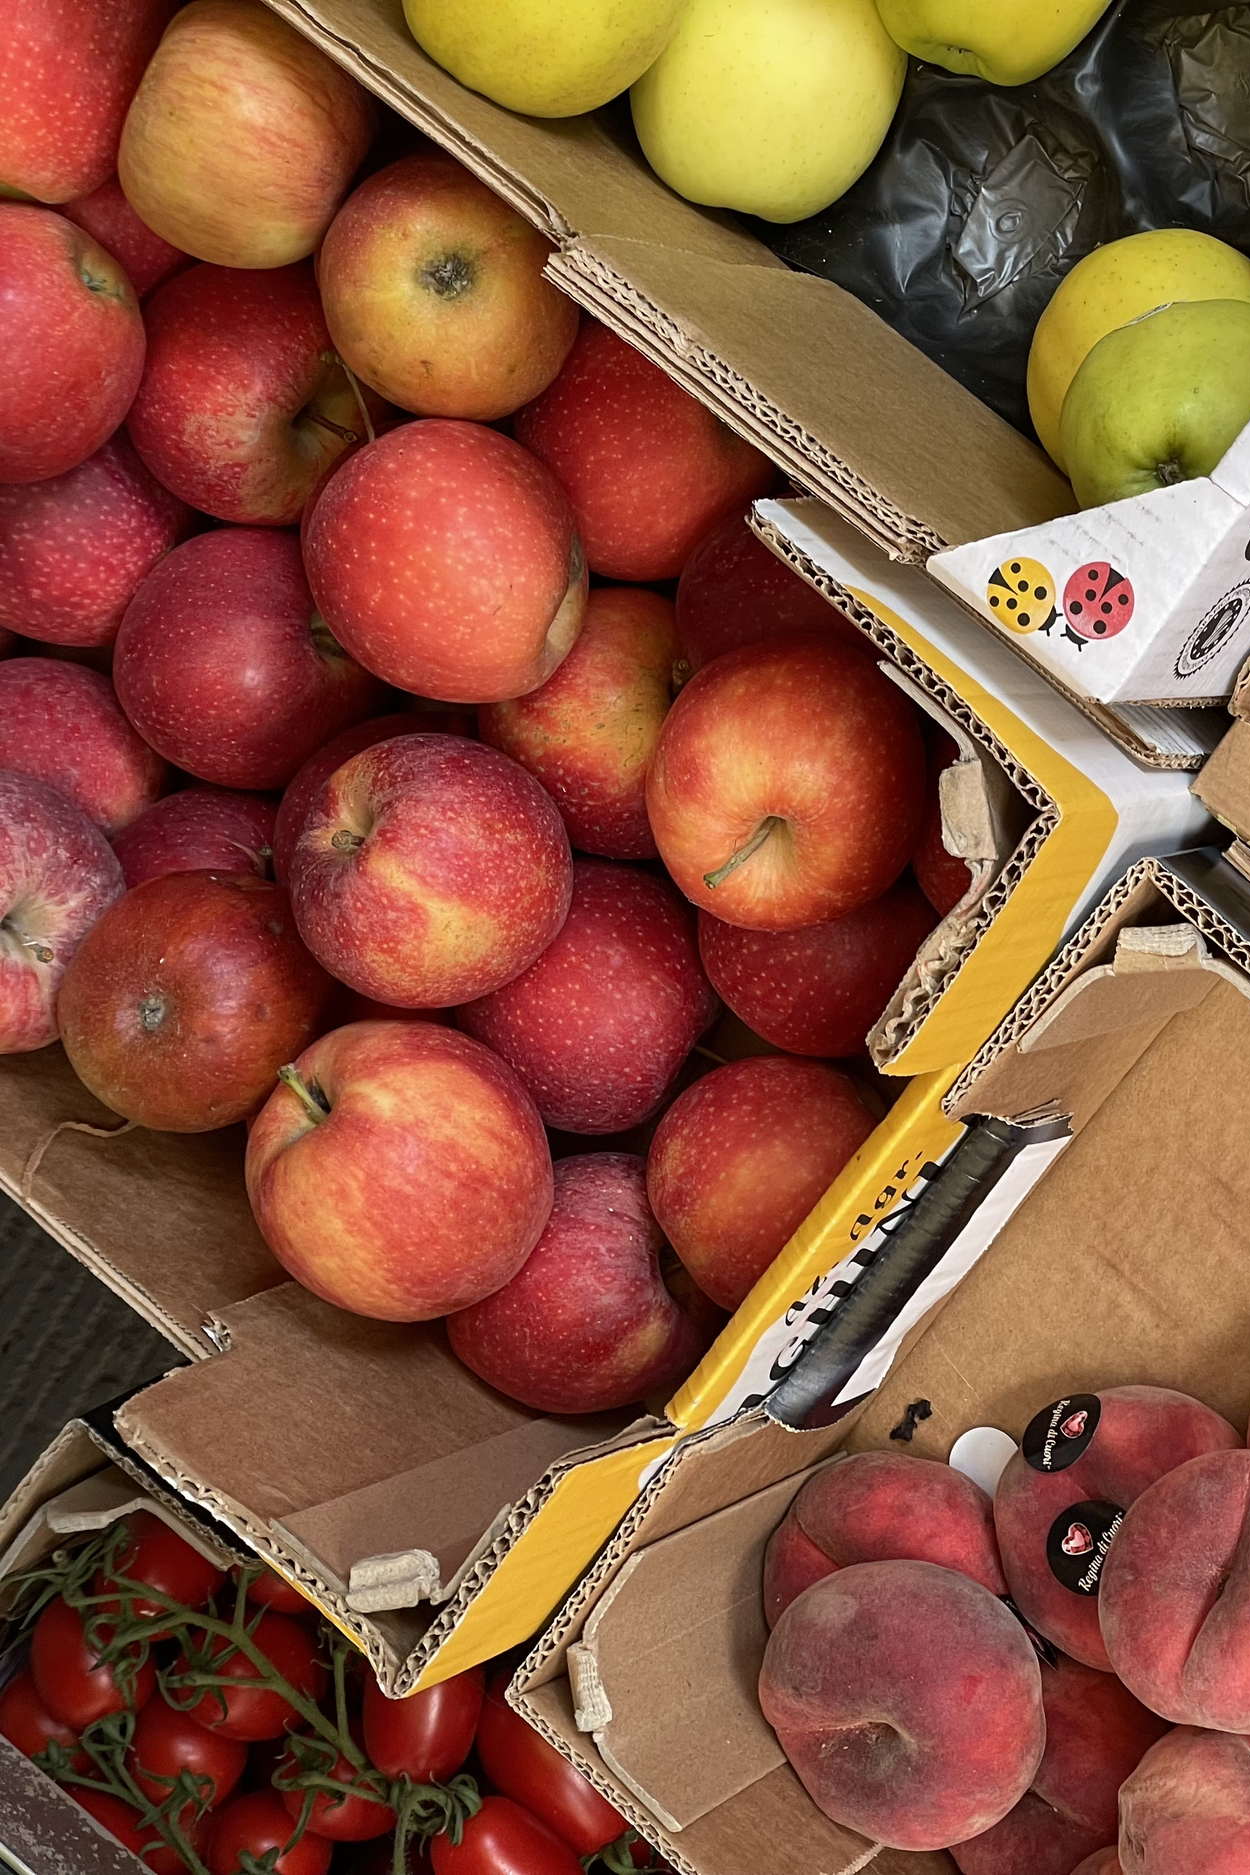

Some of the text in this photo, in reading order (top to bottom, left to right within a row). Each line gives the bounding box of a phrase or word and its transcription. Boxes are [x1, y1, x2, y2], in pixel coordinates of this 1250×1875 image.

[850, 1151, 923, 1240] Agr.
[1047, 1429, 1058, 1438] di
[1050, 1400, 1070, 1428] Regina
[1078, 1554, 1103, 1592] Regina
[1097, 1541, 1109, 1555] di
